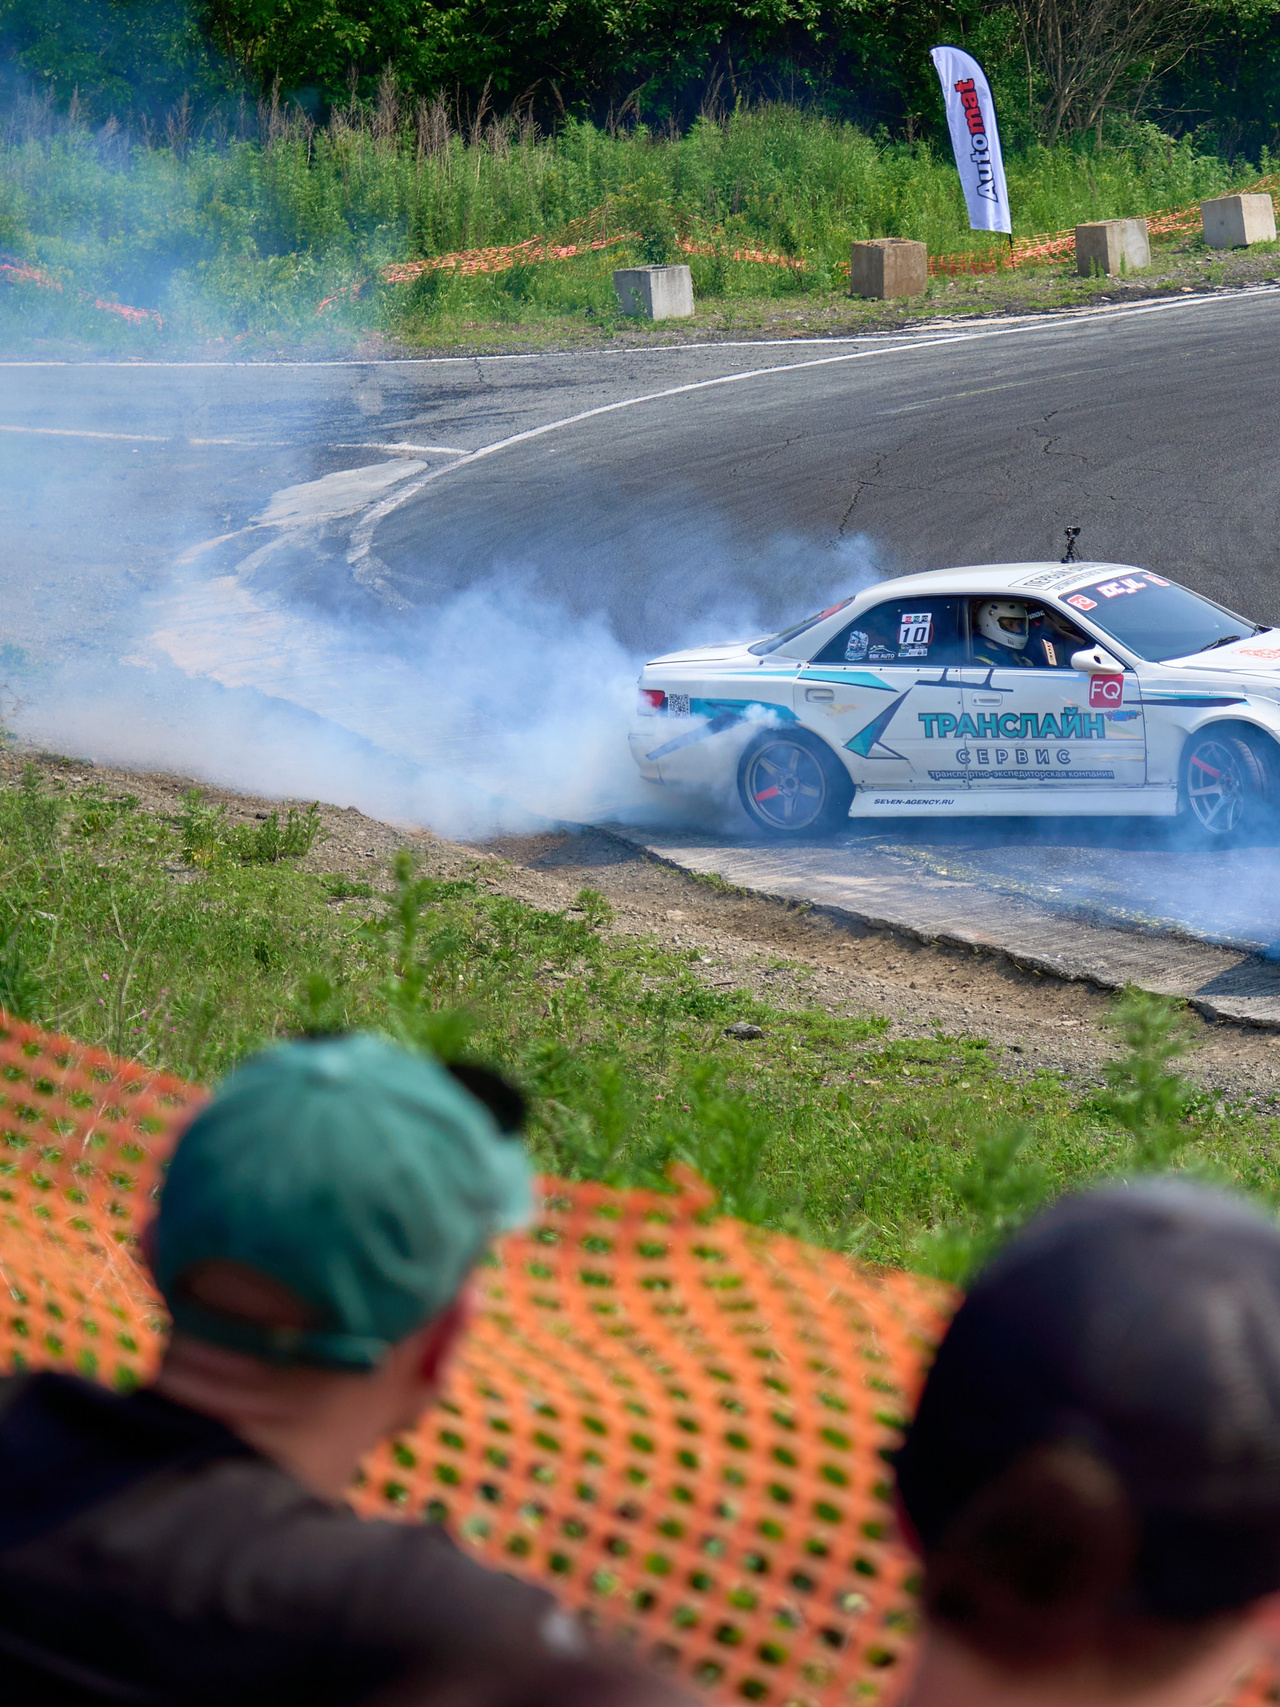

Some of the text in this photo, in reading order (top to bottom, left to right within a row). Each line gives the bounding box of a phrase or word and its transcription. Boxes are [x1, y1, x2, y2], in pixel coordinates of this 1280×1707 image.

[954, 78, 998, 203] Automat
[903, 627, 926, 643] 10
[1091, 681, 1121, 699] FQ
[918, 707, 1105, 738] ТРАНСЛАЙН
[956, 749, 1071, 764] СЕРВИС
[930, 770, 1066, 780] транспортно-экспедиторская
